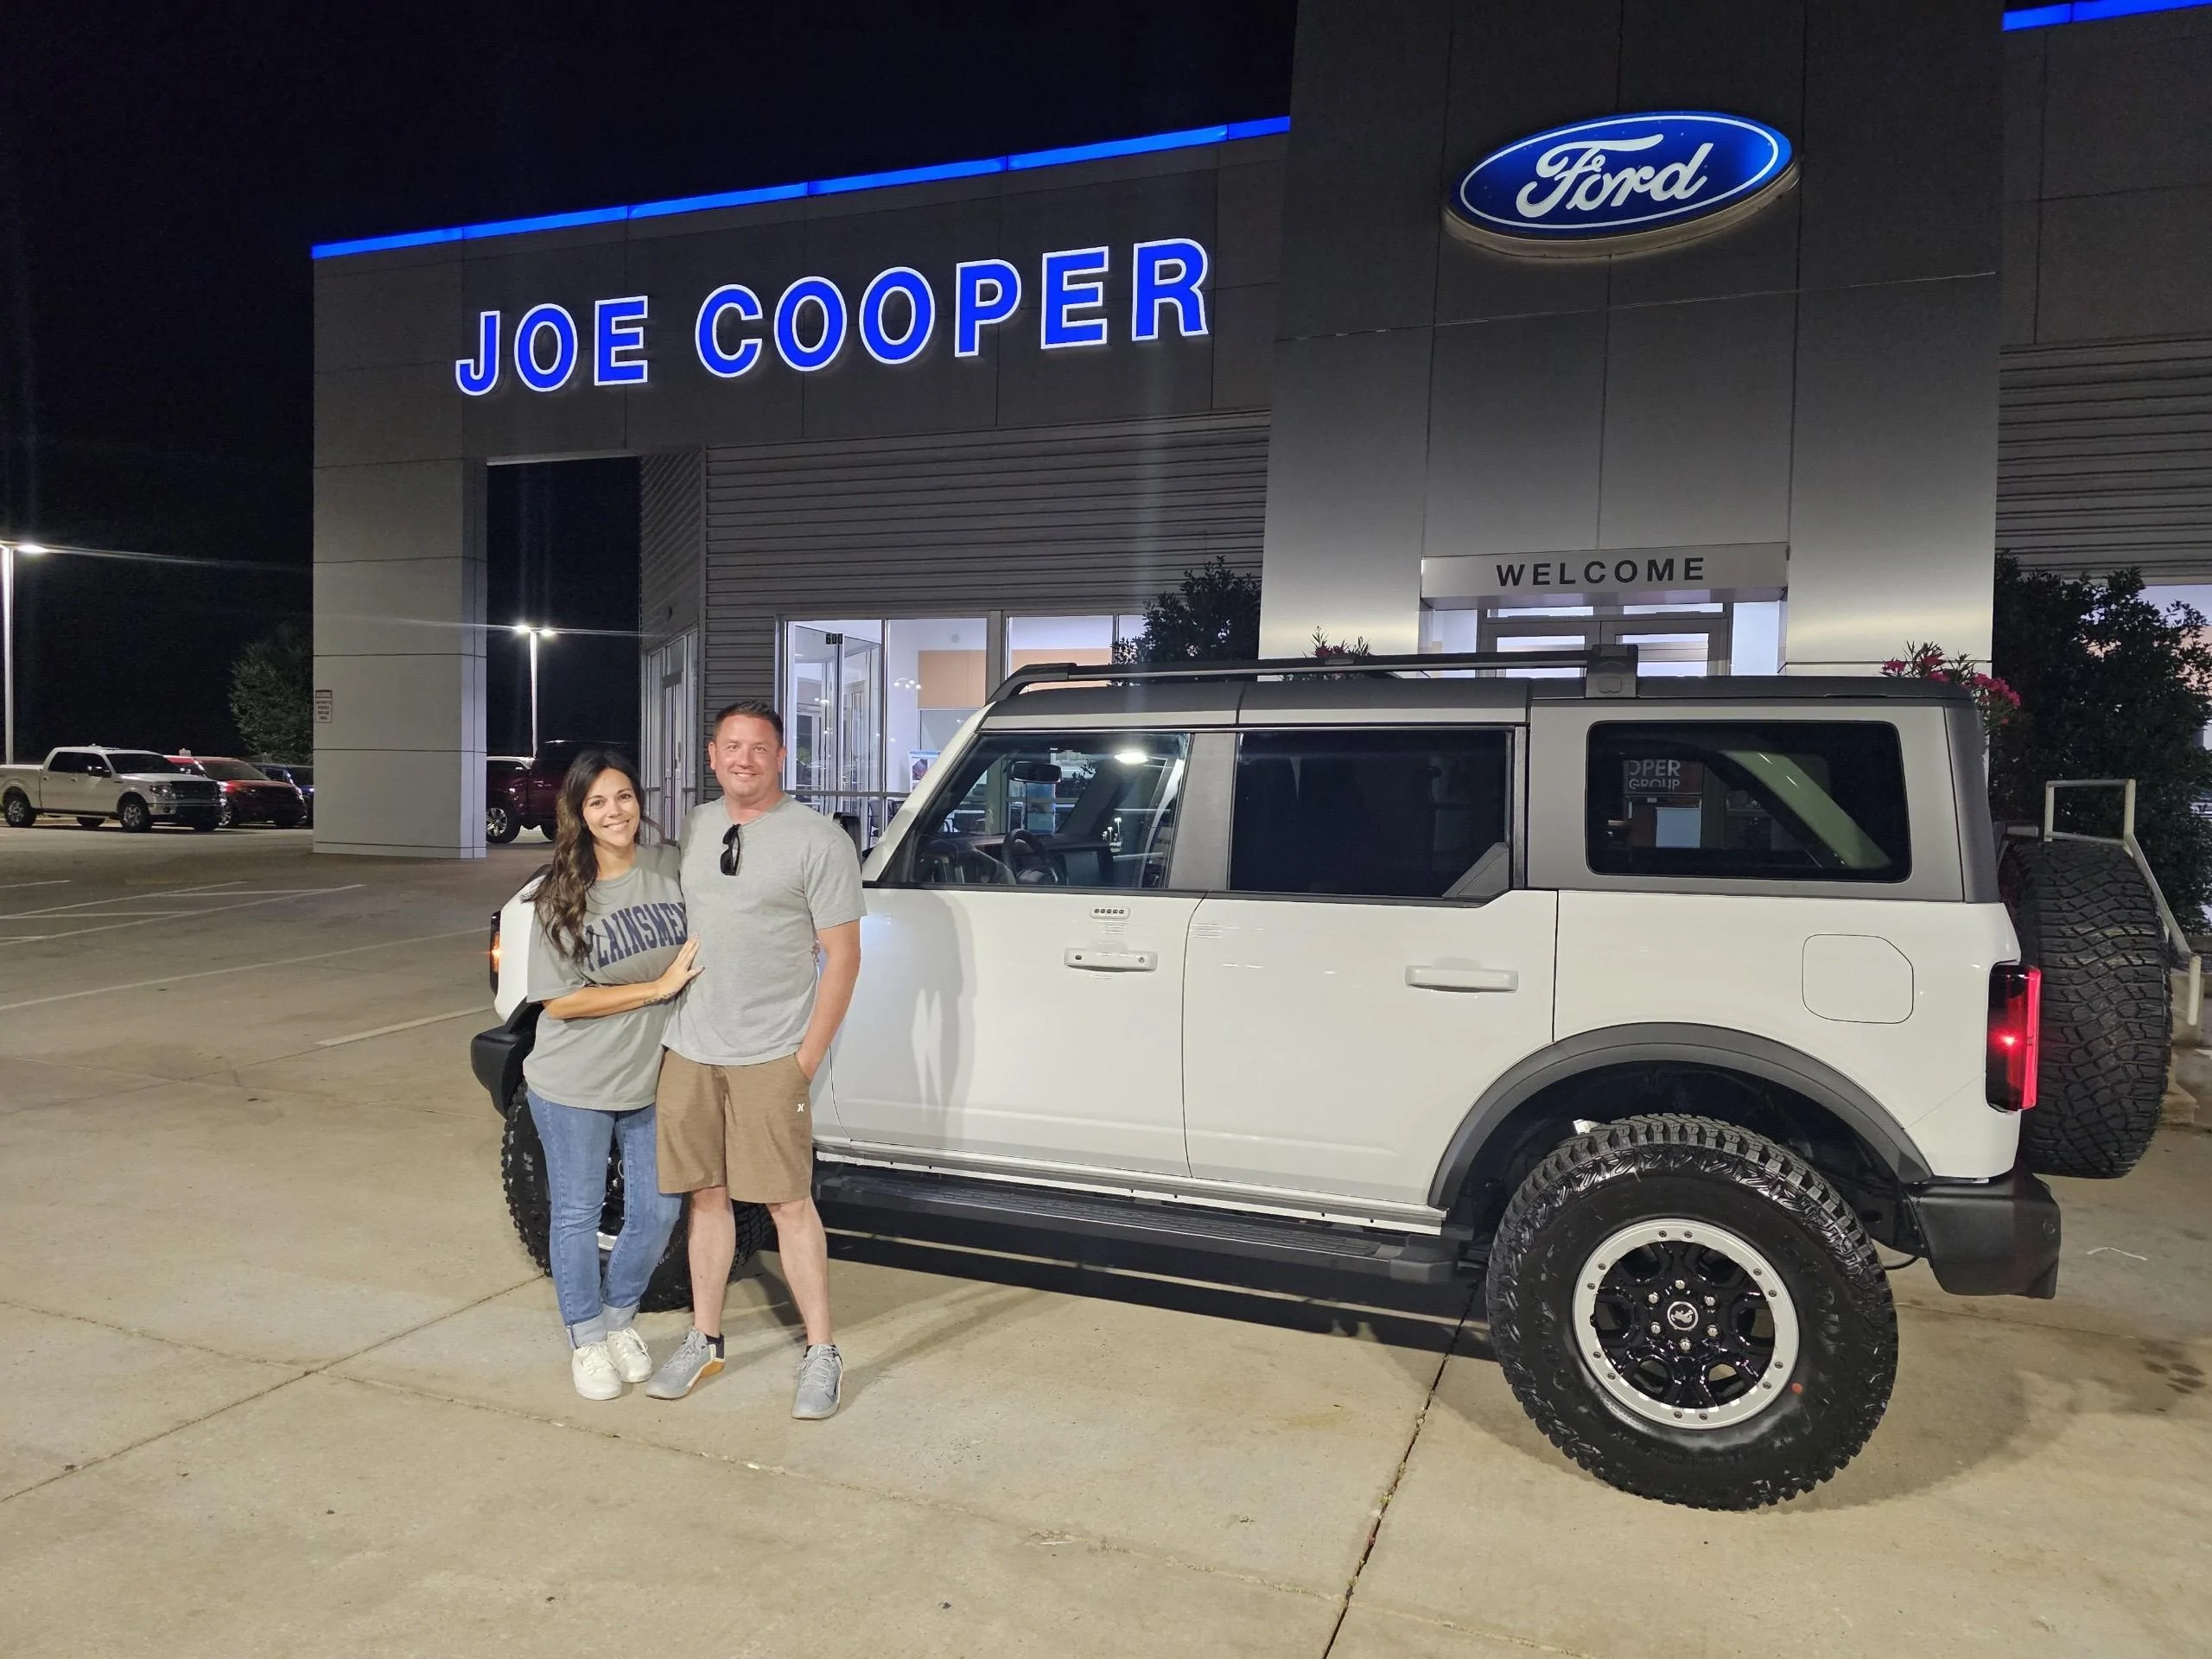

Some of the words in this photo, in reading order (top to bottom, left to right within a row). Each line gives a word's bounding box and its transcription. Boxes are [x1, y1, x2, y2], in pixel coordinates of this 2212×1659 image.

[1516, 134, 1713, 218] Ford
[454, 296, 648, 396] JOE
[695, 237, 1209, 378] COOPER
[1497, 557, 1704, 587] WELCOME
